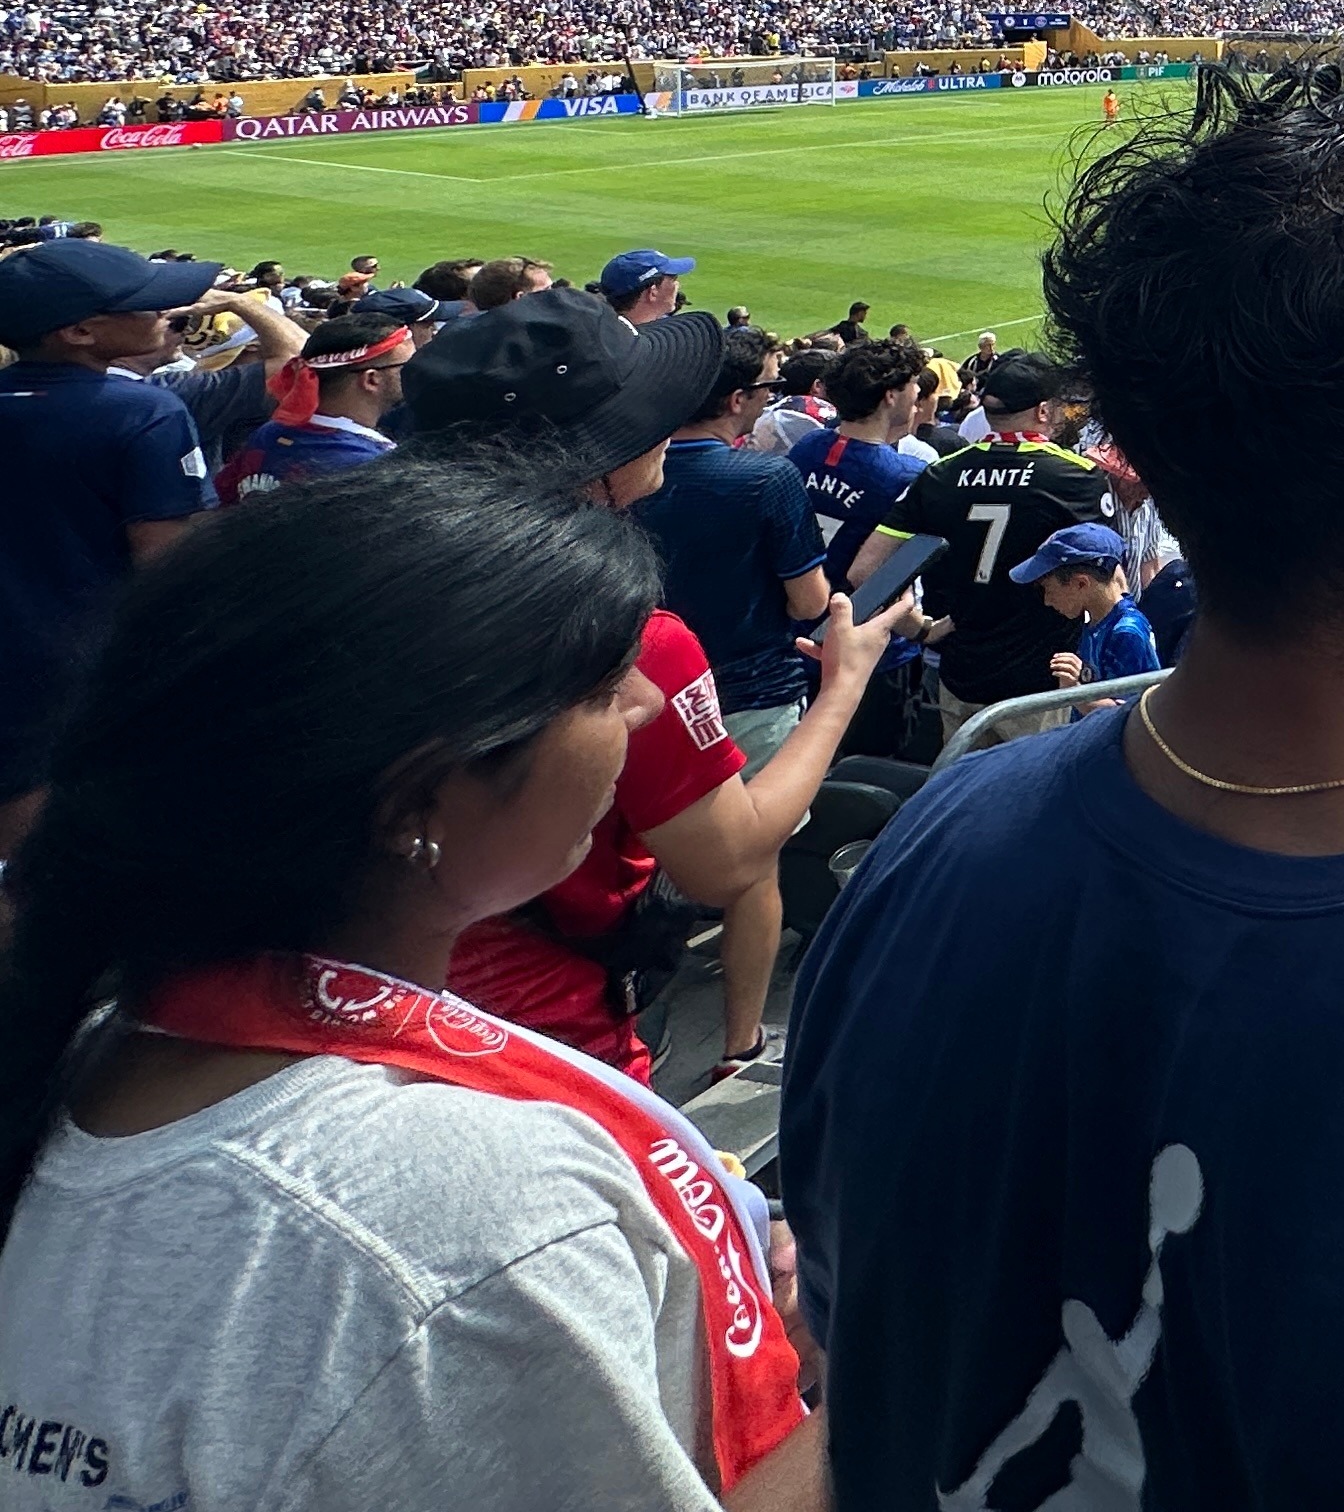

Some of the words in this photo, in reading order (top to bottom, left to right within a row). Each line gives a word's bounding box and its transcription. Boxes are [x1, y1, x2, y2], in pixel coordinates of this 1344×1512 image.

[1037, 67, 1112, 86] motorola
[1148, 66, 1165, 77] PIF
[690, 90, 735, 106] BANK
[740, 89, 761, 103] OF
[763, 85, 835, 102] AMERICA
[872, 79, 926, 95] Michelob
[938, 76, 986, 90] ULTRA
[562, 95, 619, 117] VISA
[235, 114, 338, 140] QATAR
[350, 104, 469, 131] AIRWAYS
[100, 123, 188, 151] Coca-Cola
[957, 462, 1035, 487] KANTÉ
[805, 471, 865, 509] ANTÉ
[966, 503, 1012, 584] 7
